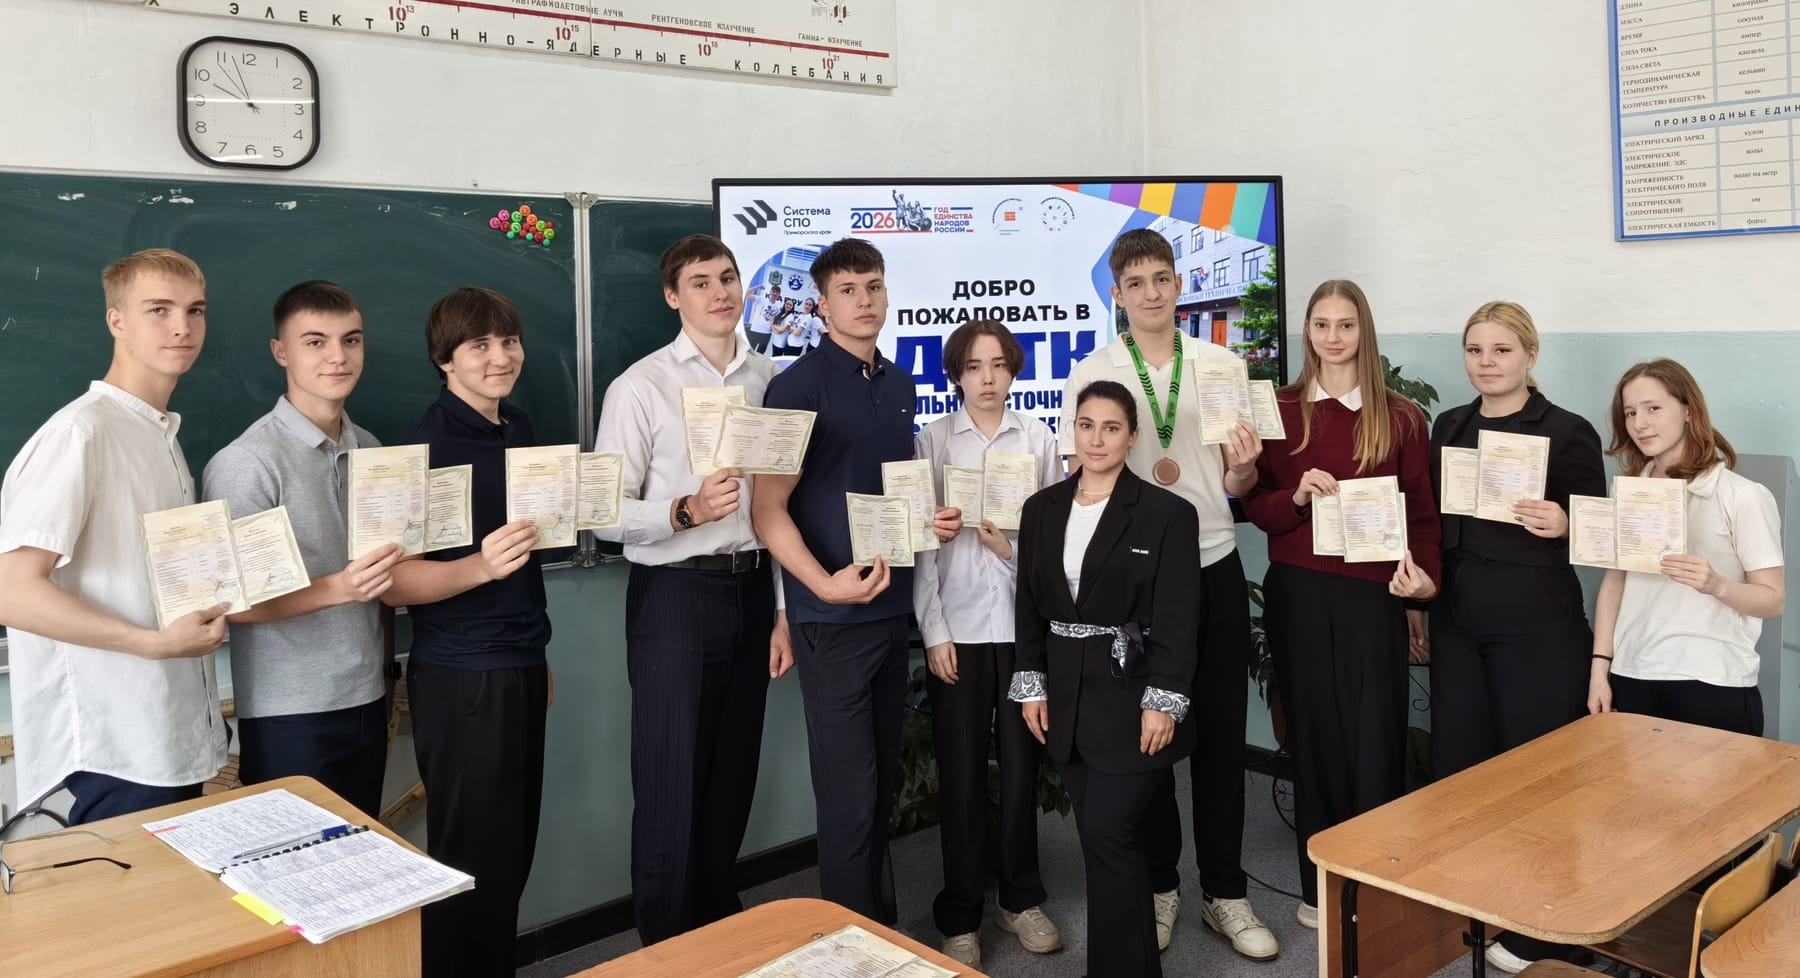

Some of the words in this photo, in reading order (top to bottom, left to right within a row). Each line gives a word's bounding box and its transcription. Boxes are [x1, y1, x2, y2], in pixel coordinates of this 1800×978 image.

[603, 8, 624, 18] ЛУЧИ
[651, 14, 712, 29] РЕНТГЕНОВСКОЕ
[716, 22, 756, 34] ИЗЛУЧЕНИЕ
[1620, 17, 1643, 25] МАССА
[1737, 15, 1764, 24] секунда
[1620, 33, 1643, 41] ВРЕМЯ
[1741, 31, 1762, 39] ампер
[828, 37, 863, 48] ИЗЛУЧЕНИЕ
[216, 51, 226, 63] 11
[1620, 49, 1639, 57] СИЛА
[1640, 46, 1657, 54] ТОКА
[243, 52, 257, 66] 12
[275, 57, 279, 69] 1
[734, 60, 883, 84] КОЛЕБАНИЯ
[1621, 64, 1639, 72] СИЛА
[1640, 61, 1661, 69] СВЕТА
[194, 68, 210, 82] 10
[1623, 71, 1701, 86] ТЕРМОДИНАМИЧЕСКАЯ
[292, 77, 303, 90] 2
[1623, 84, 1668, 95] ТЕМПЕРАТУРА
[1623, 99, 1667, 110] КОЛИЧЕСТВО
[1669, 94, 1706, 104] ВЕЩЕСТВА
[294, 103, 305, 116] 3
[1654, 109, 1756, 128] ПРОИЗВОДНЫЕ
[195, 121, 207, 134] 8
[292, 130, 303, 141] 4
[1625, 136, 1682, 147] ЭЛЕКТРИЧЕСКИЙ
[1684, 134, 1705, 142] ЗАРЯД
[217, 141, 228, 154] 7
[245, 144, 257, 156] 6
[272, 146, 284, 158] 5
[1625, 151, 1681, 161] ЭЛЕКТРИЧЕСКОЕ
[1625, 175, 1685, 185] НАПРЯЖЕННОСТЬ
[1625, 184, 1686, 193] ЭЛЕКТРИЧЕСКОГО
[1627, 198, 1682, 207] ЭЛЕКТРИЧЕСКОЕ
[783, 205, 831, 216] Система
[1625, 207, 1685, 216] СОПРОТИВЛЕНИЕ
[783, 217, 811, 228] СПО
[850, 212, 895, 229] 2026
[1627, 223, 1682, 231] ЭЛЕКТРИЧЕСКАЯ
[952, 279, 1036, 300] ДОБРО
[897, 304, 1068, 325] ПОЖАЛОВАТЬ
[1076, 304, 1090, 320] В
[895, 330, 1096, 392] ДТК
